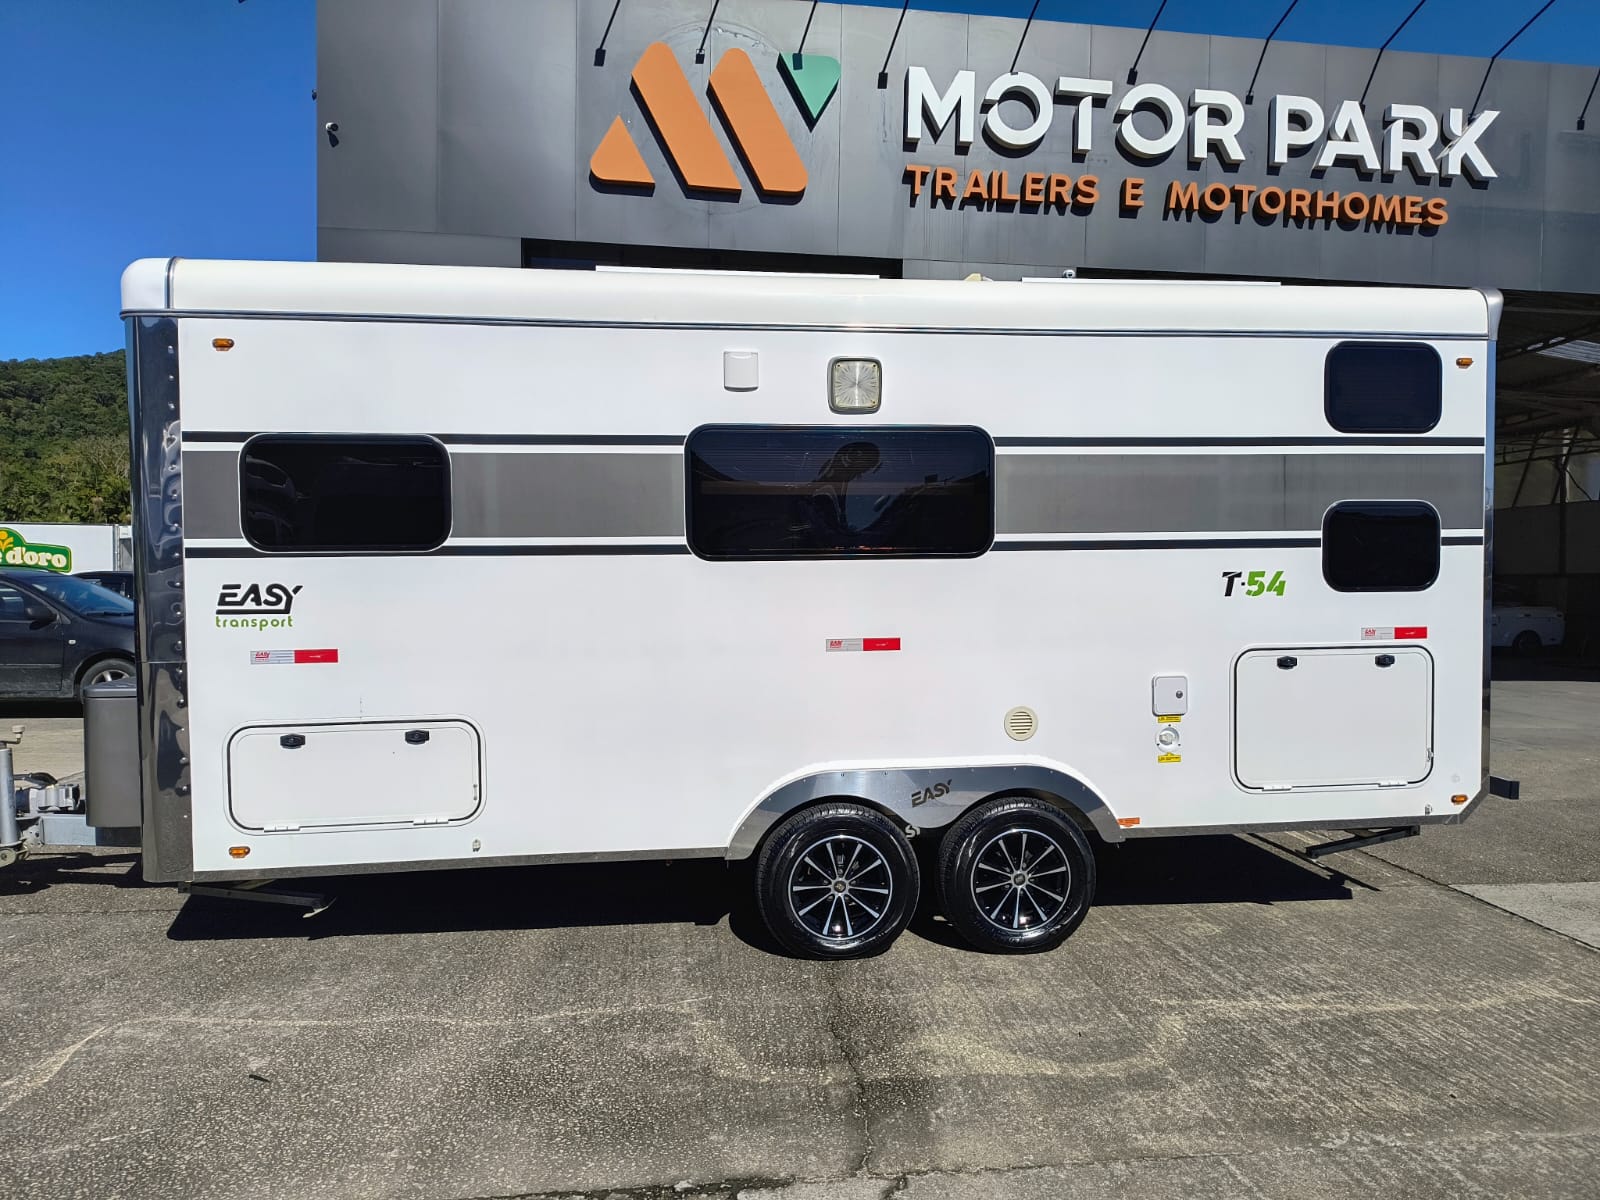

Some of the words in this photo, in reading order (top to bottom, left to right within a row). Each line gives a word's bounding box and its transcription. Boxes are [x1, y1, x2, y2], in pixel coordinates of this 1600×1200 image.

[906, 66, 1246, 164] MOTOR
[1271, 94, 1501, 179] PARK
[906, 164, 1100, 205] TRAILERS
[1125, 177, 1145, 207] E
[1168, 180, 1450, 227] MOTORHOMES
[216, 583, 303, 615] EASY
[215, 616, 293, 631] transport
[911, 779, 952, 808] EASY
